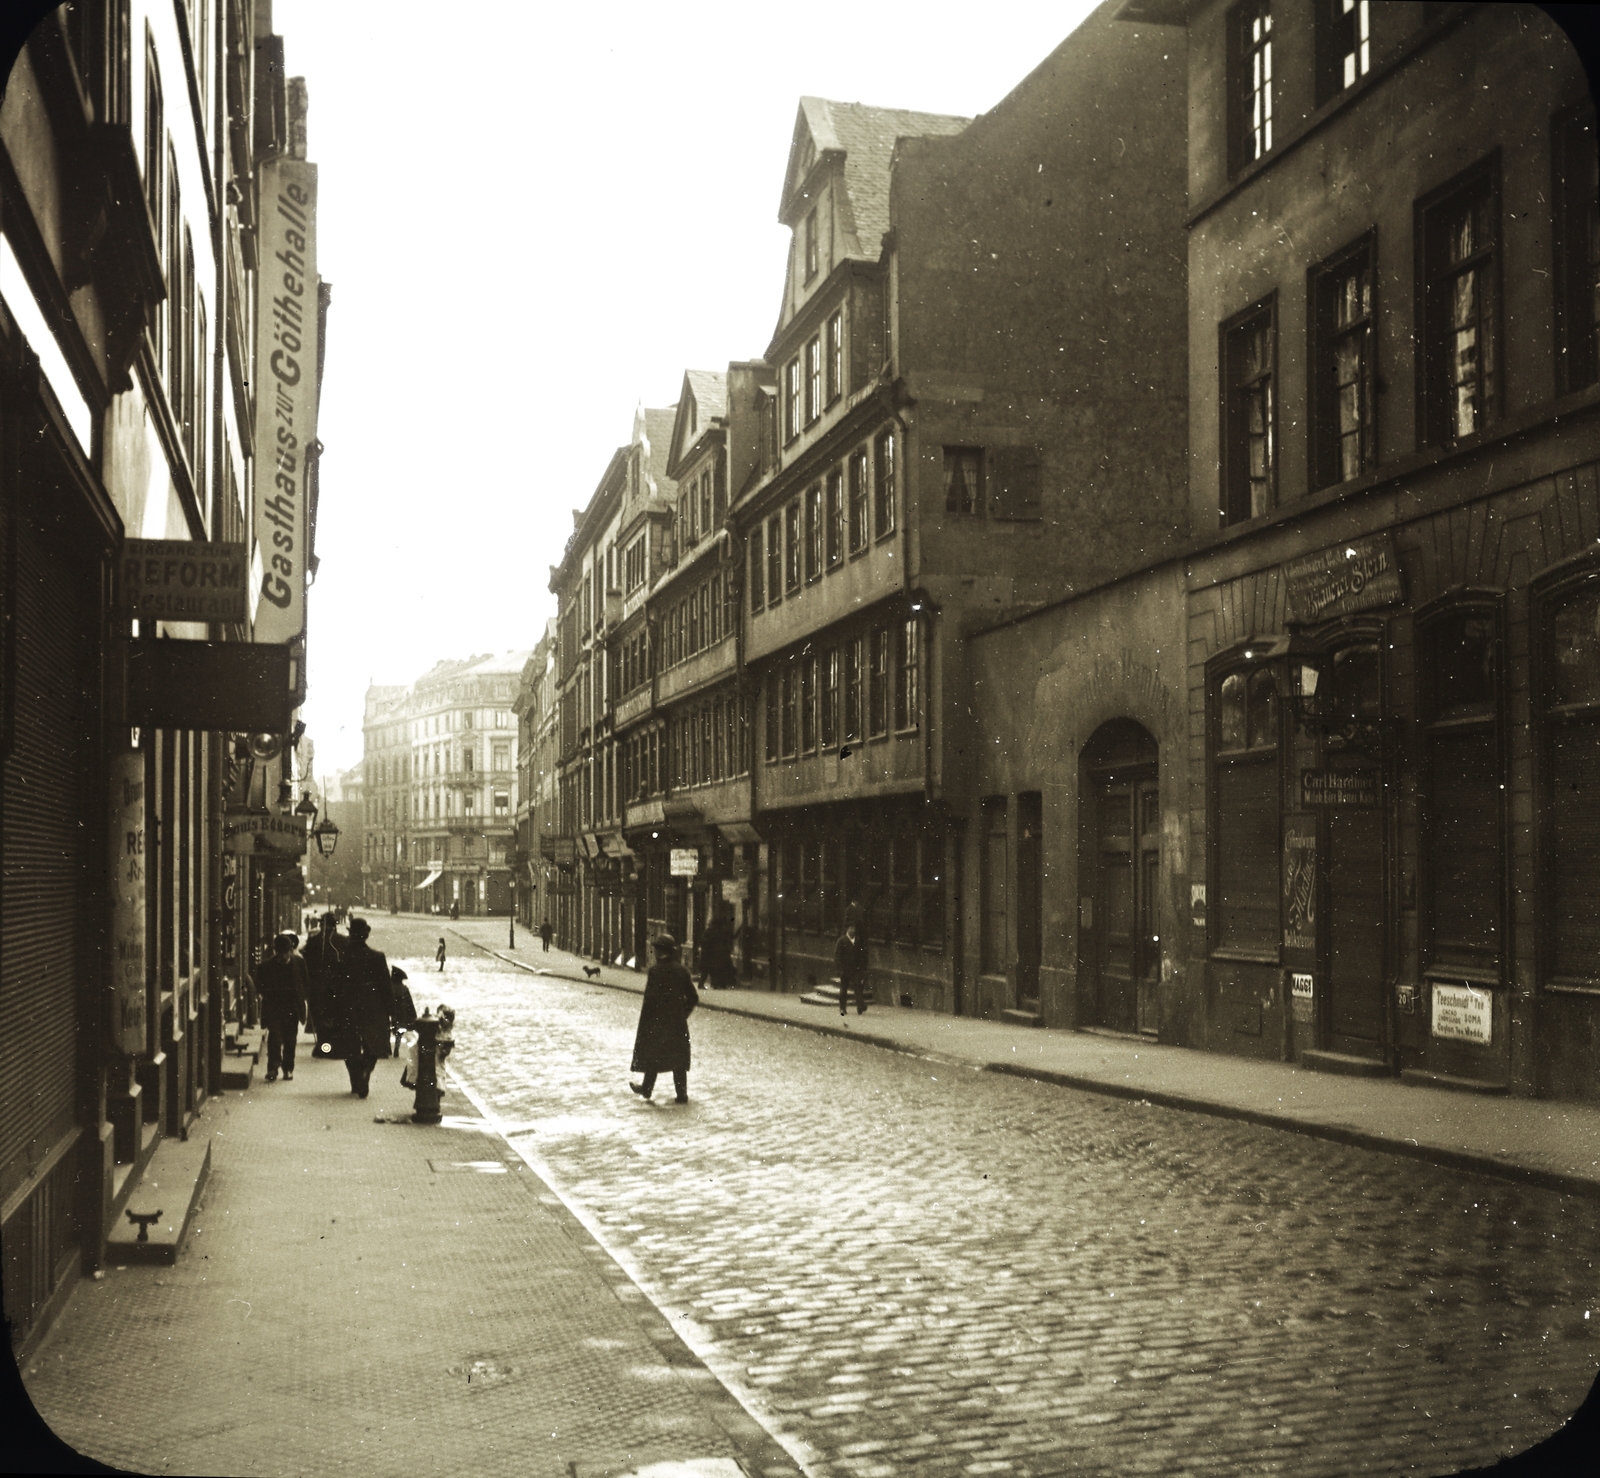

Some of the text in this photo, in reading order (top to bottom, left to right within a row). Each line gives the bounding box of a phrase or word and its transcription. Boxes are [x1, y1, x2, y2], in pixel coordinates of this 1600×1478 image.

[262, 182, 309, 610] Gasthaus zur Göthehalle
[124, 558, 240, 589] REFORM
[127, 589, 238, 614] Restaurant
[1304, 773, 1327, 788] Carl
[1398, 994, 1407, 1005] 20
